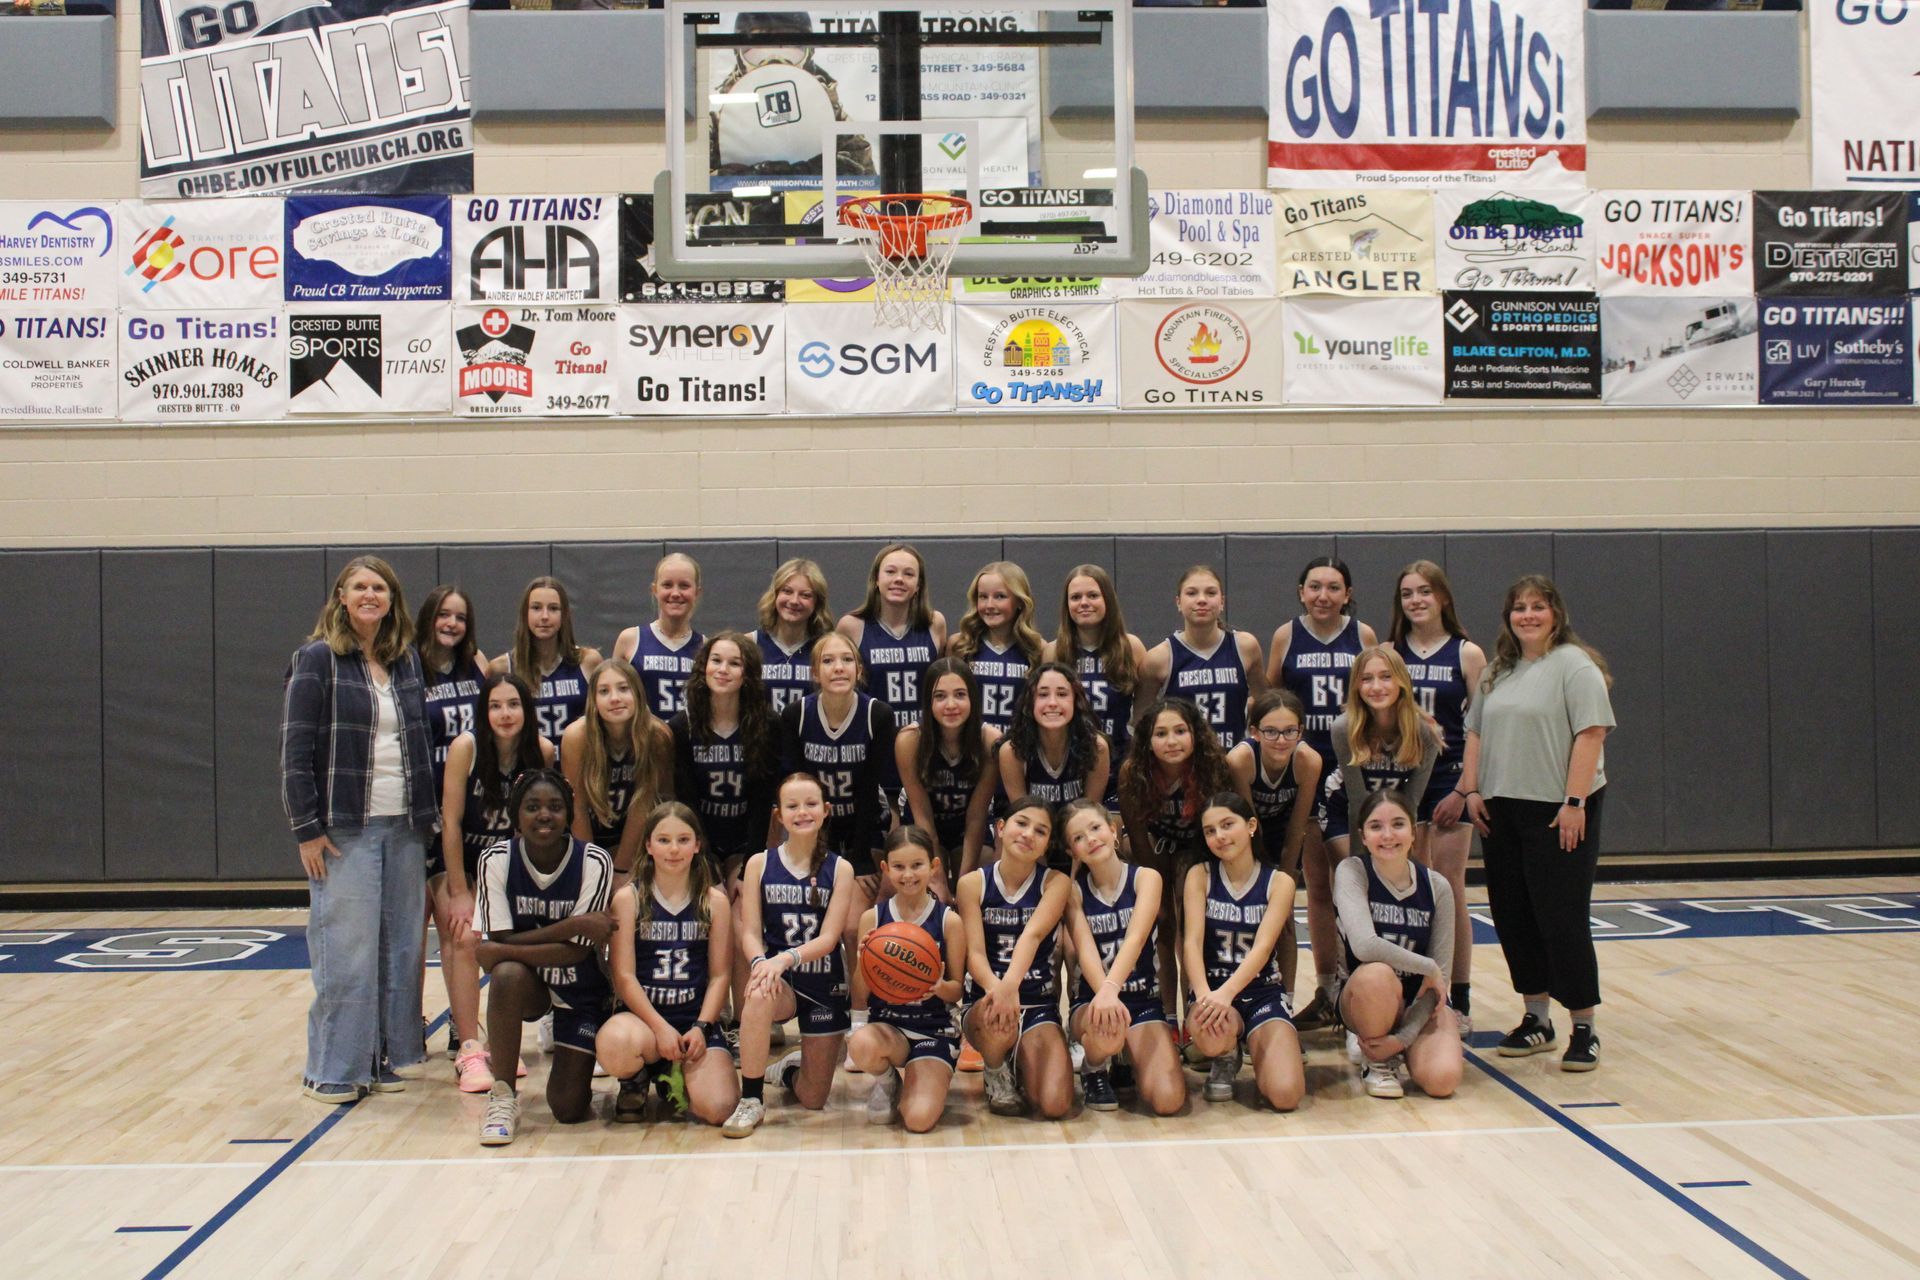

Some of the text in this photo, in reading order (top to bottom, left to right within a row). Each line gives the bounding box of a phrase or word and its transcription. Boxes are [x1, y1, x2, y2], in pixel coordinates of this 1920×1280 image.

[1836, 0, 1909, 25] GO
[177, 0, 260, 50] GO
[1285, 0, 1564, 139] GO TITANS!
[1488, 147, 1536, 158] crested
[1844, 140, 1920, 171] NATI
[177, 127, 464, 198] OHBEJOYFULCHURCH.ORG
[983, 165, 1018, 173] HEALTH
[1496, 158, 1530, 169] butte
[1355, 173, 1496, 185] Proud Sponsor of the Titans!
[982, 189, 1085, 205] GO TITANS!
[1164, 192, 1274, 216] Diamond Blue
[467, 197, 603, 222] GO TITANS!
[1284, 194, 1368, 225] Go Titans
[1604, 199, 1744, 224] GO TITANS!
[1778, 206, 1885, 228] Go Titans!
[310, 209, 427, 235] Crested Butte
[41, 234, 95, 249] DENTISTRY
[307, 226, 430, 251] Savings Loan
[1179, 219, 1261, 249] Pool Spa
[1484, 223, 1509, 241] Be
[470, 225, 600, 299] AHA
[1152, 252, 1254, 267] 49-6202
[1292, 251, 1418, 263] CRESTED BUTTE
[1765, 241, 1899, 269] DIETRICH
[1600, 243, 1745, 289] JACKSON'S
[3, 272, 66, 284] 349-5731
[1293, 269, 1422, 292] ANGLER
[1455, 266, 1579, 292] Go Titans!
[1789, 271, 1874, 283] 970-275-0201
[32, 288, 86, 300] TITANS!
[293, 284, 442, 299] Proud CB Titan Supporters
[1010, 284, 1100, 299] GRAPHICS T-SHIRTS
[1159, 286, 1255, 296] Tubs Pool Tables
[520, 309, 617, 323] Dr. Tom Moore
[1491, 301, 1600, 313] GUNNISON VALLEY
[1764, 306, 1905, 326] GO TITANS!!!
[291, 319, 380, 332] CRESTED BUTTE
[1163, 308, 1245, 342] MOUNTAIN FIREPLACE
[1491, 312, 1598, 324] ORTHOPEDICS
[14, 317, 107, 339] TITANS!
[128, 316, 278, 340] Go Titans!
[1502, 323, 1598, 333] SPORTS MEDICINE
[408, 339, 432, 353] GO
[983, 308, 1091, 368] CRESTED BUTTE ELECTRICAL
[1324, 334, 1430, 361] younglife
[289, 336, 381, 360] SPORTS
[570, 341, 592, 358] Go
[1453, 345, 1591, 359] BLAKE CLIFTON, M.D.
[1797, 339, 1905, 359] LIV Sotheby's
[3, 359, 110, 369] COLDWELL BANKER
[124, 347, 279, 389] SKINNER HOMES
[386, 359, 446, 375] TITANS!
[555, 359, 608, 375] Titans!
[838, 342, 937, 376] SGM
[1169, 357, 1231, 379] SPECIALISTS
[34, 374, 81, 382] MOUNTAIN
[1010, 368, 1065, 377] 349-5265
[1454, 364, 1590, 375] Adult Sports Medicine
[1705, 372, 1755, 381] IRWIN
[31, 381, 83, 389] PROPERTIES
[464, 367, 528, 393] MOORE
[637, 376, 767, 402] Go Titans!
[1453, 380, 1592, 392] U.S. Snowboard Physician
[152, 383, 244, 400] 970.901.7383
[971, 381, 1004, 405] GO
[157, 404, 223, 414] CRESTED BUTTE
[546, 395, 611, 411] 349-2677
[643, 655, 678, 672] CRESTED
[870, 646, 931, 664] CRESTED BUTTE
[1296, 652, 1331, 669] CRESTED
[1178, 667, 1238, 688] CRESTED BUTTE
[1428, 665, 1454, 682] BUTTE
[425, 680, 481, 703] CRESTED BUTTE
[555, 679, 581, 696] BUTTE
[804, 742, 867, 764] CRESTED BUTTE
[709, 770, 743, 797] 24
[818, 770, 853, 797] 42
[765, 883, 803, 904] CRESTED
[653, 948, 691, 981] 32
[883, 940, 933, 977] Wilson
